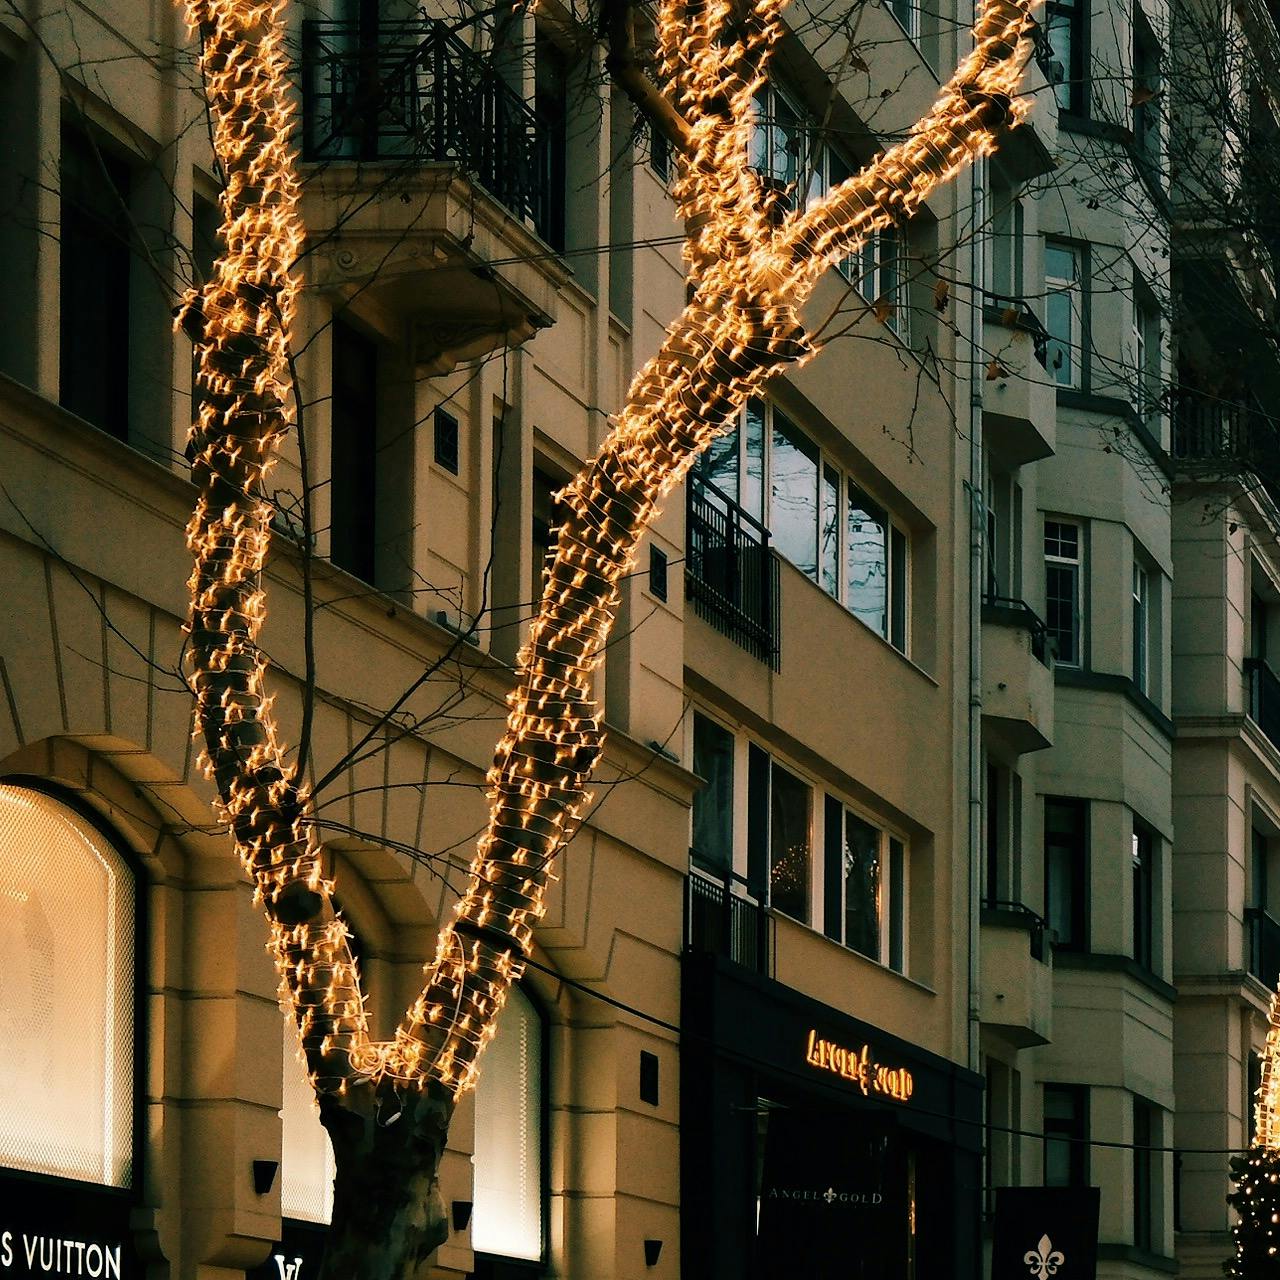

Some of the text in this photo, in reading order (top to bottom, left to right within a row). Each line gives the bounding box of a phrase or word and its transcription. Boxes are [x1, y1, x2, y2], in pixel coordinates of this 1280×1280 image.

[768, 1187, 883, 1204] ANGEL GOLD
[22, 1233, 121, 1280] VUITTON
